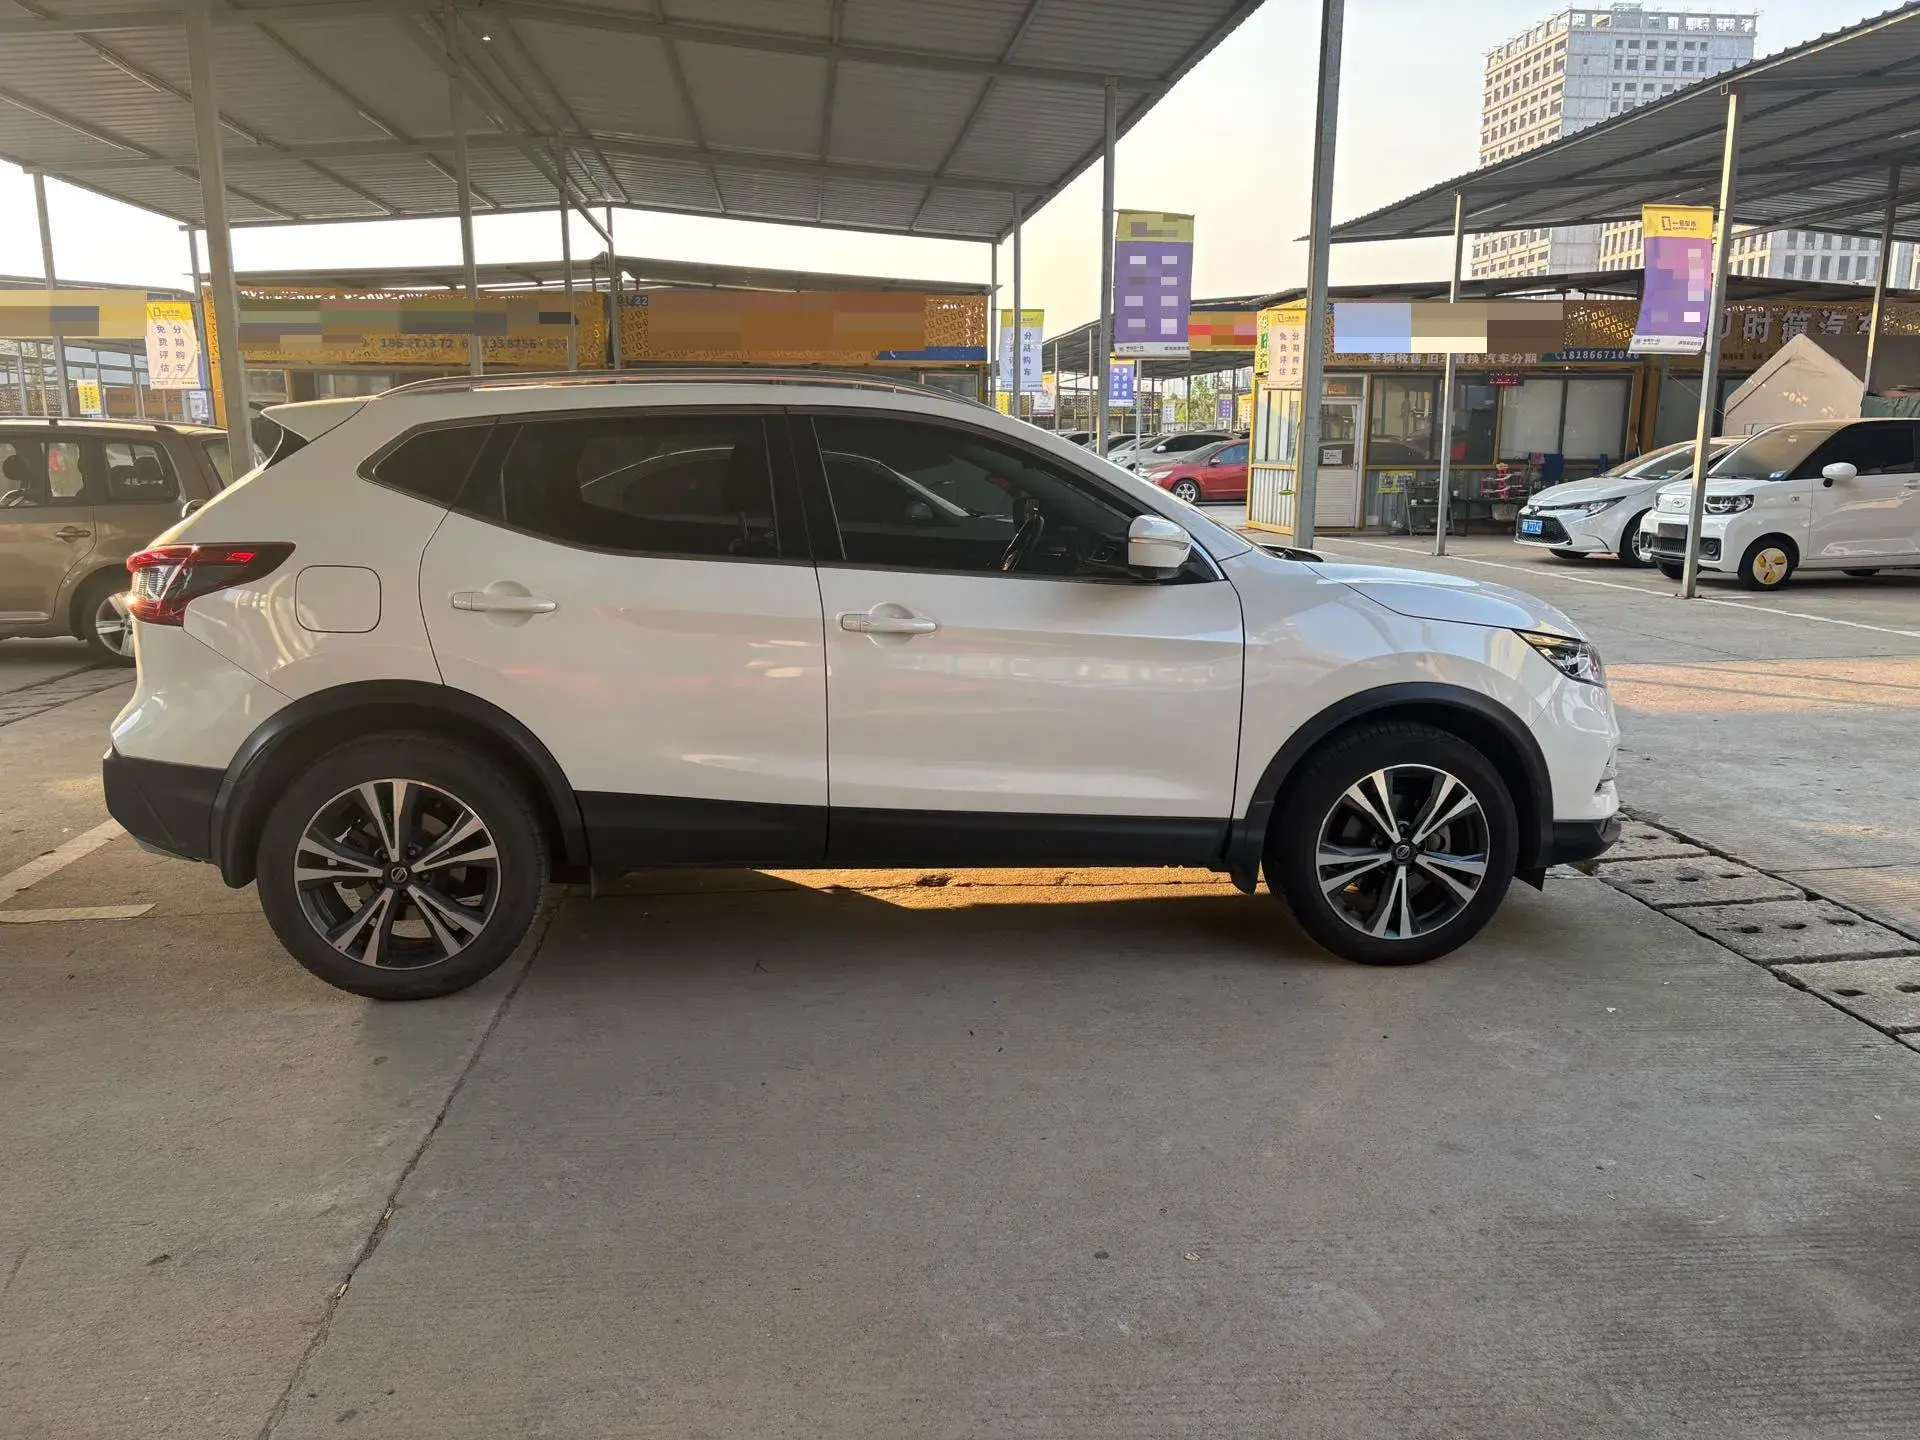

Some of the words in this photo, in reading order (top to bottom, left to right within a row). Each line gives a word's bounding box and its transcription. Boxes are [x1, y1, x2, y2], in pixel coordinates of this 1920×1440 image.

[156, 325, 169, 372] 免费评估
[173, 325, 185, 373] 分期购车
[1279, 332, 1288, 375] 免费评估
[1291, 331, 1300, 375] 分期购车
[1483, 353, 1538, 364] 汽车分期
